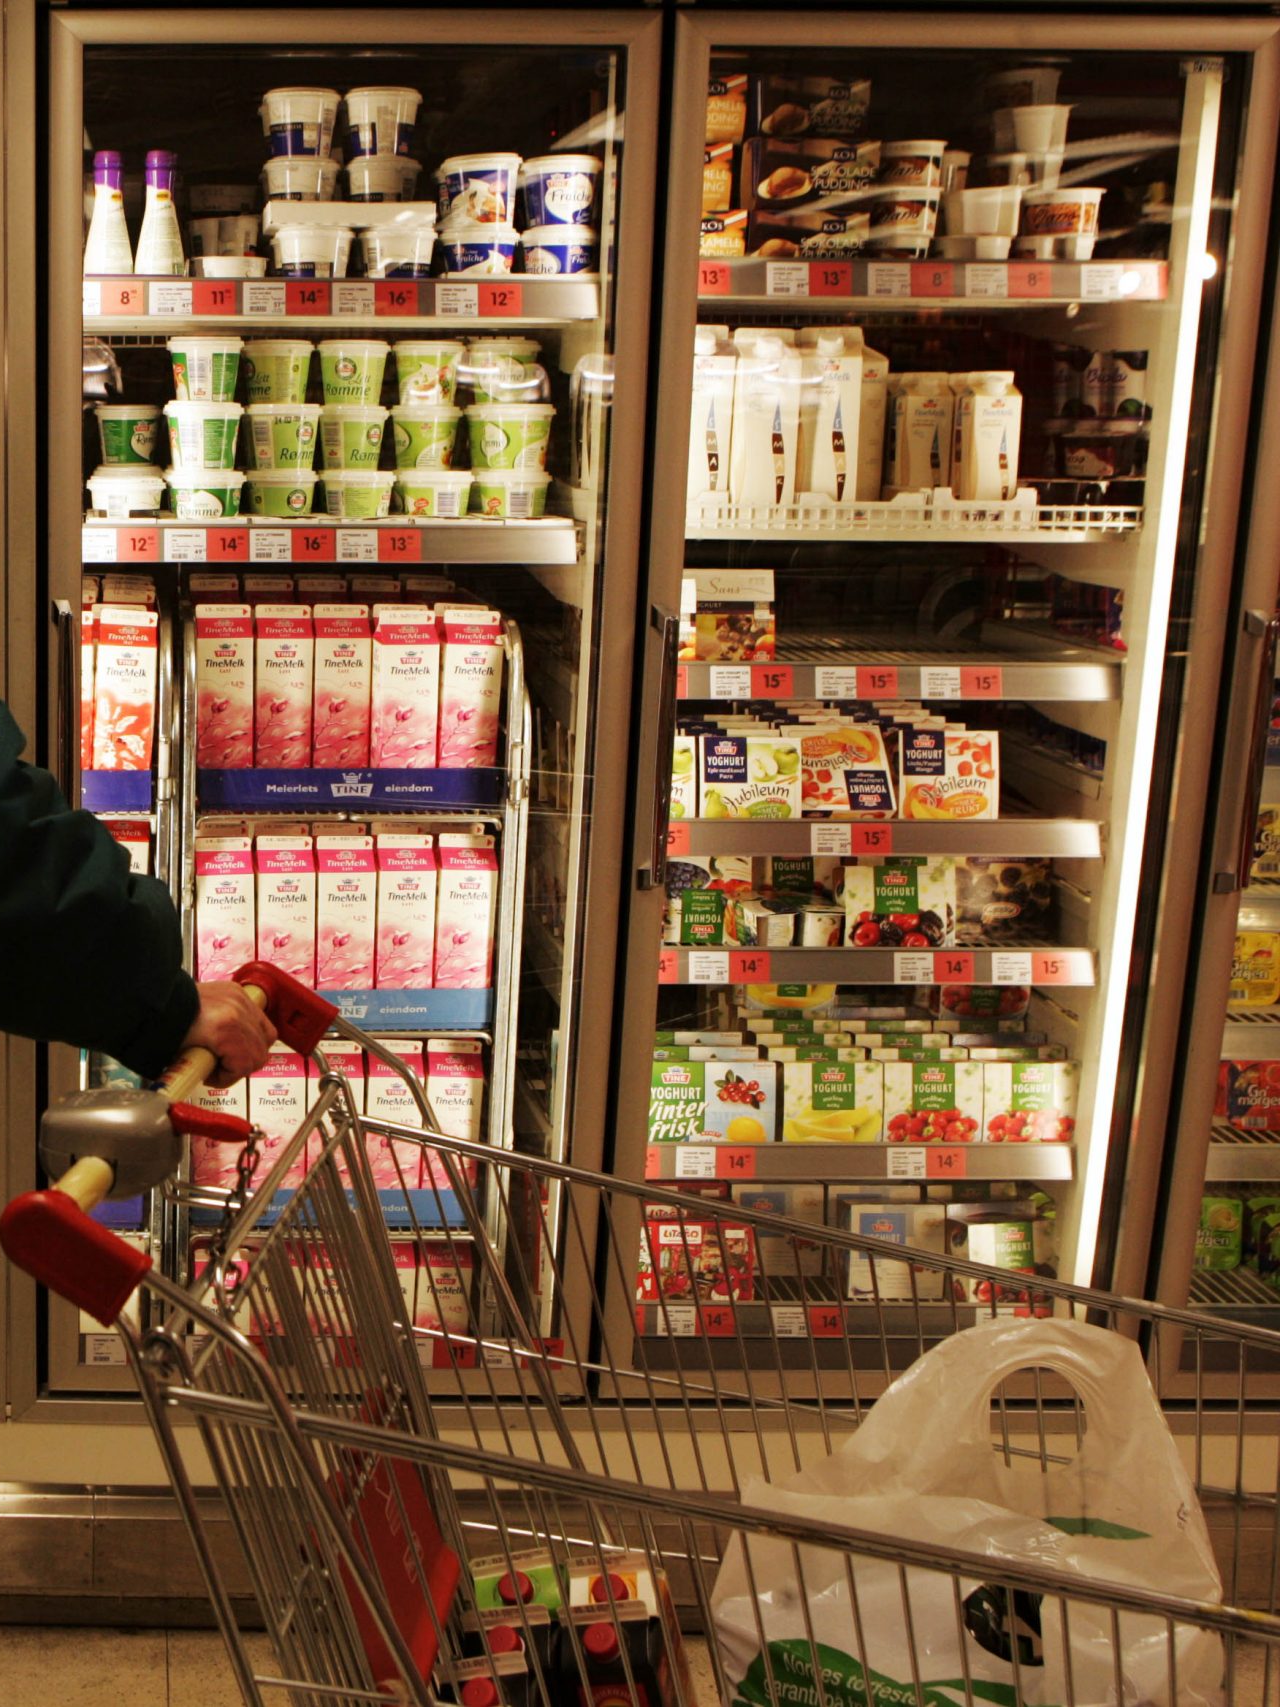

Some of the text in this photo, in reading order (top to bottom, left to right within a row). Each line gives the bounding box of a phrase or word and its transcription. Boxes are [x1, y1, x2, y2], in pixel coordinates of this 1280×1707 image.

[833, 150, 856, 161] KOS
[814, 178, 870, 191] PUDDING
[701, 221, 724, 232] KOS
[823, 222, 845, 232] KOS
[701, 270, 719, 285] 13
[823, 270, 840, 286] 13
[120, 290, 130, 305] 8
[211, 290, 225, 305] 11
[299, 290, 317, 305] 14
[388, 291, 407, 305] 16
[490, 291, 508, 306] 12
[324, 383, 371, 397] Rømme
[130, 537, 147, 552] 12
[220, 537, 238, 551] 14
[303, 536, 321, 551] 16
[389, 536, 407, 551] 13
[107, 633, 149, 642] TineMelk
[205, 658, 245, 669] TineMelk
[265, 659, 305, 669] TineMelk
[324, 659, 364, 669] TineMelk
[400, 657, 423, 665] TINE
[464, 657, 487, 665] TINE
[106, 666, 147, 678] TineMelk
[390, 666, 431, 676] TineMelk
[454, 665, 495, 677] TineMelk
[763, 673, 781, 688] 15
[870, 674, 888, 688] 15
[975, 676, 991, 690] 15
[905, 749, 943, 760] YOGHURT
[707, 756, 746, 766] YOGHURT
[266, 783, 434, 795] Meieriets TINE eiendom
[849, 784, 888, 794] YOGHURT
[918, 776, 987, 808] Jubileum
[724, 781, 792, 814] Jubileum
[864, 831, 880, 846] 15
[773, 861, 812, 872] YOGHURT
[886, 875, 906, 884] TINE
[277, 885, 299, 893] TINE
[337, 884, 359, 892] TINE
[397, 883, 420, 891] TINE
[459, 882, 481, 890] TINE
[876, 886, 916, 897] YOGHURT
[206, 895, 247, 905] TineMelk
[267, 894, 308, 904] TineMelk
[327, 893, 367, 903] TineMelk
[387, 891, 428, 901] TineMelk
[449, 890, 489, 900] TineMelk
[684, 913, 722, 924] YOGHURT
[740, 959, 757, 973] 14
[946, 960, 963, 974] 14
[1042, 961, 1059, 975] 15
[1231, 969, 1270, 981] orgen
[380, 1005, 428, 1015] eiendom
[262, 1063, 298, 1073] ineMelk
[664, 1074, 689, 1083] TINE
[268, 1088, 289, 1096] TINE
[385, 1088, 407, 1096] TINE
[650, 1086, 702, 1100] YOGHURT
[814, 1083, 853, 1093] YOGHURT
[913, 1083, 953, 1093] YOGHURT
[1013, 1083, 1052, 1094] YOGHURT
[199, 1096, 238, 1107] TineMelk
[258, 1096, 298, 1107] TineMelk
[376, 1096, 415, 1107] TineMelk
[435, 1096, 474, 1107] TineMelk
[649, 1117, 700, 1142] frisk
[729, 1155, 745, 1169] 14
[937, 1155, 953, 1169] 14
